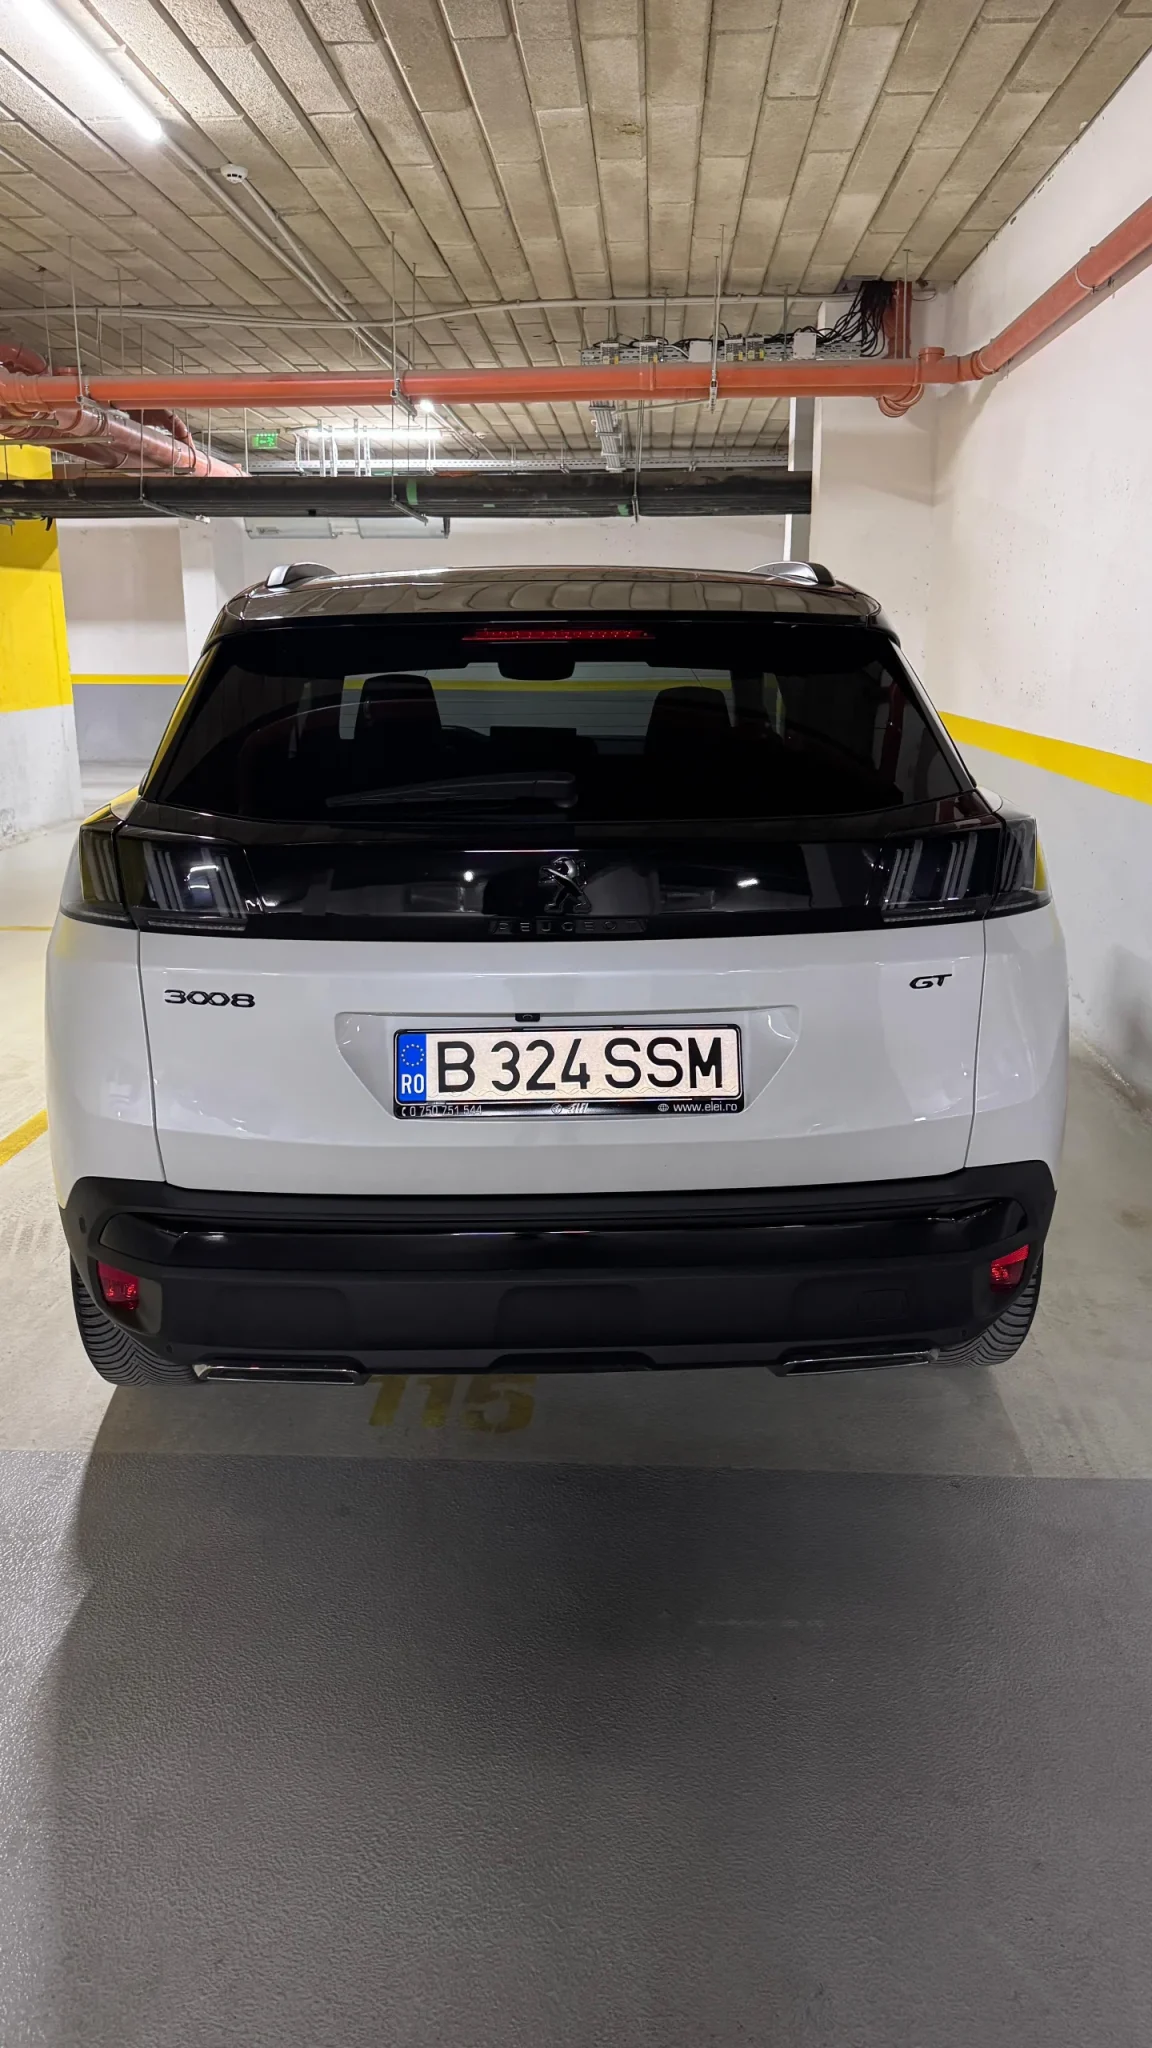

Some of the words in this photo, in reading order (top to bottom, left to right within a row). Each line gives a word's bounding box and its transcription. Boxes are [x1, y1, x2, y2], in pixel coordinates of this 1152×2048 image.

[909, 973, 953, 990] GT
[164, 989, 256, 1008] 3008
[437, 1041, 476, 1093] B
[491, 1038, 591, 1091] 324
[604, 1037, 723, 1089] SSM
[401, 1073, 425, 1095] RO
[442, 1105, 459, 1116] 751
[463, 1105, 482, 1116] 544
[673, 1101, 738, 1112] www.elei.ro
[368, 1374, 537, 1433] 115
